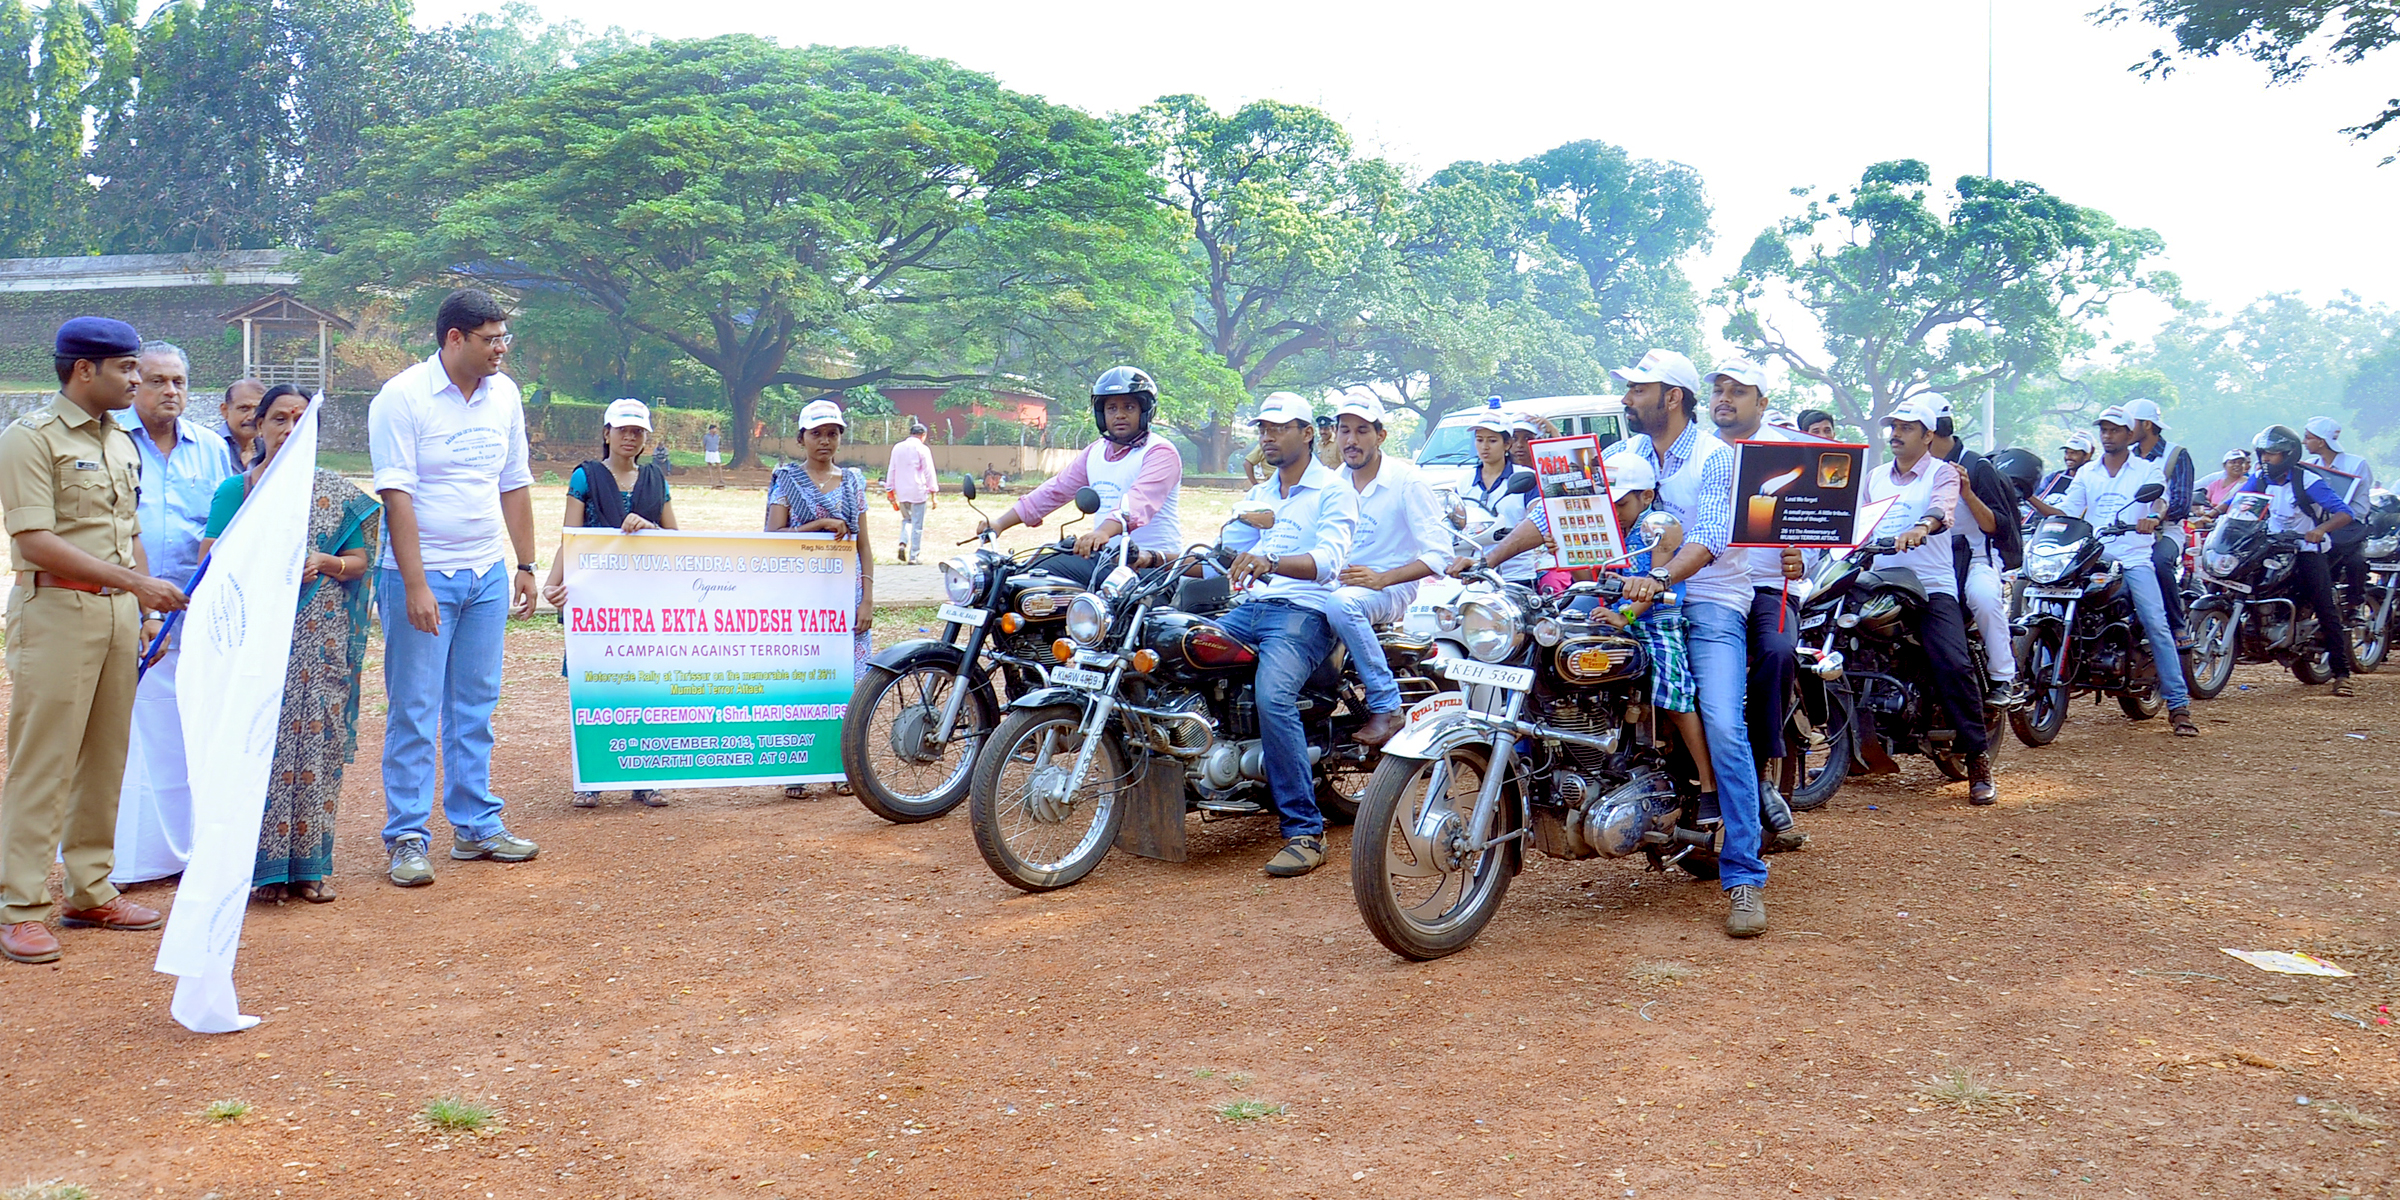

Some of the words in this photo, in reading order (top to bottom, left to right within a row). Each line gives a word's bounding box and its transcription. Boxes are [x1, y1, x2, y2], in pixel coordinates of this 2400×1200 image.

[1538, 455, 1569, 474] 26/11
[579, 553, 629, 571] NEHRU
[632, 554, 672, 572] YUVA
[675, 555, 734, 572] KENDRA
[737, 556, 747, 573] &
[750, 556, 805, 573] CADETS
[808, 557, 844, 574] CLUB
[692, 578, 737, 602] Organise
[571, 607, 656, 633] RASHTRA
[661, 608, 709, 633] EKTA
[714, 608, 793, 633] SANDESH
[798, 609, 848, 633] YATRA
[604, 645, 614, 657] A
[617, 644, 688, 657] CAMPAIGN
[691, 644, 747, 657] AGAINST
[750, 644, 820, 657] TERRORISM
[1191, 639, 1228, 650] Enticer
[584, 671, 636, 684] Motorcycle
[638, 670, 661, 684] Rally
[663, 671, 672, 681] at
[674, 669, 711, 681] Thrissur
[713, 672, 724, 681] on
[727, 670, 740, 680] the
[742, 669, 789, 680] memorable
[792, 669, 806, 683] day
[808, 669, 816, 680] of
[1452, 664, 1484, 677] KEH
[1489, 669, 1523, 684] 5361
[670, 684, 705, 695] Mumbai
[707, 683, 734, 694] Terror
[736, 683, 764, 694] Attack
[577, 709, 612, 724] FLAG
[615, 708, 640, 723] OFF
[643, 707, 714, 722] CEREMONY
[724, 707, 751, 721] Shri.
[753, 706, 782, 720] HARI
[784, 705, 829, 719] SANKAR
[831, 705, 848, 718] IPS
[1411, 704, 1433, 723] ROYAL
[1433, 698, 1463, 712] ENFIELD
[610, 740, 626, 751] 26
[641, 737, 718, 750] NOVEMBER
[722, 736, 755, 750] 2013,
[758, 734, 815, 747] TUESDAY
[618, 755, 692, 768] VIDYARTHI
[696, 753, 753, 766] CORNER
[759, 752, 777, 764] AT
[779, 752, 787, 763] 9
[789, 751, 808, 763] AM
